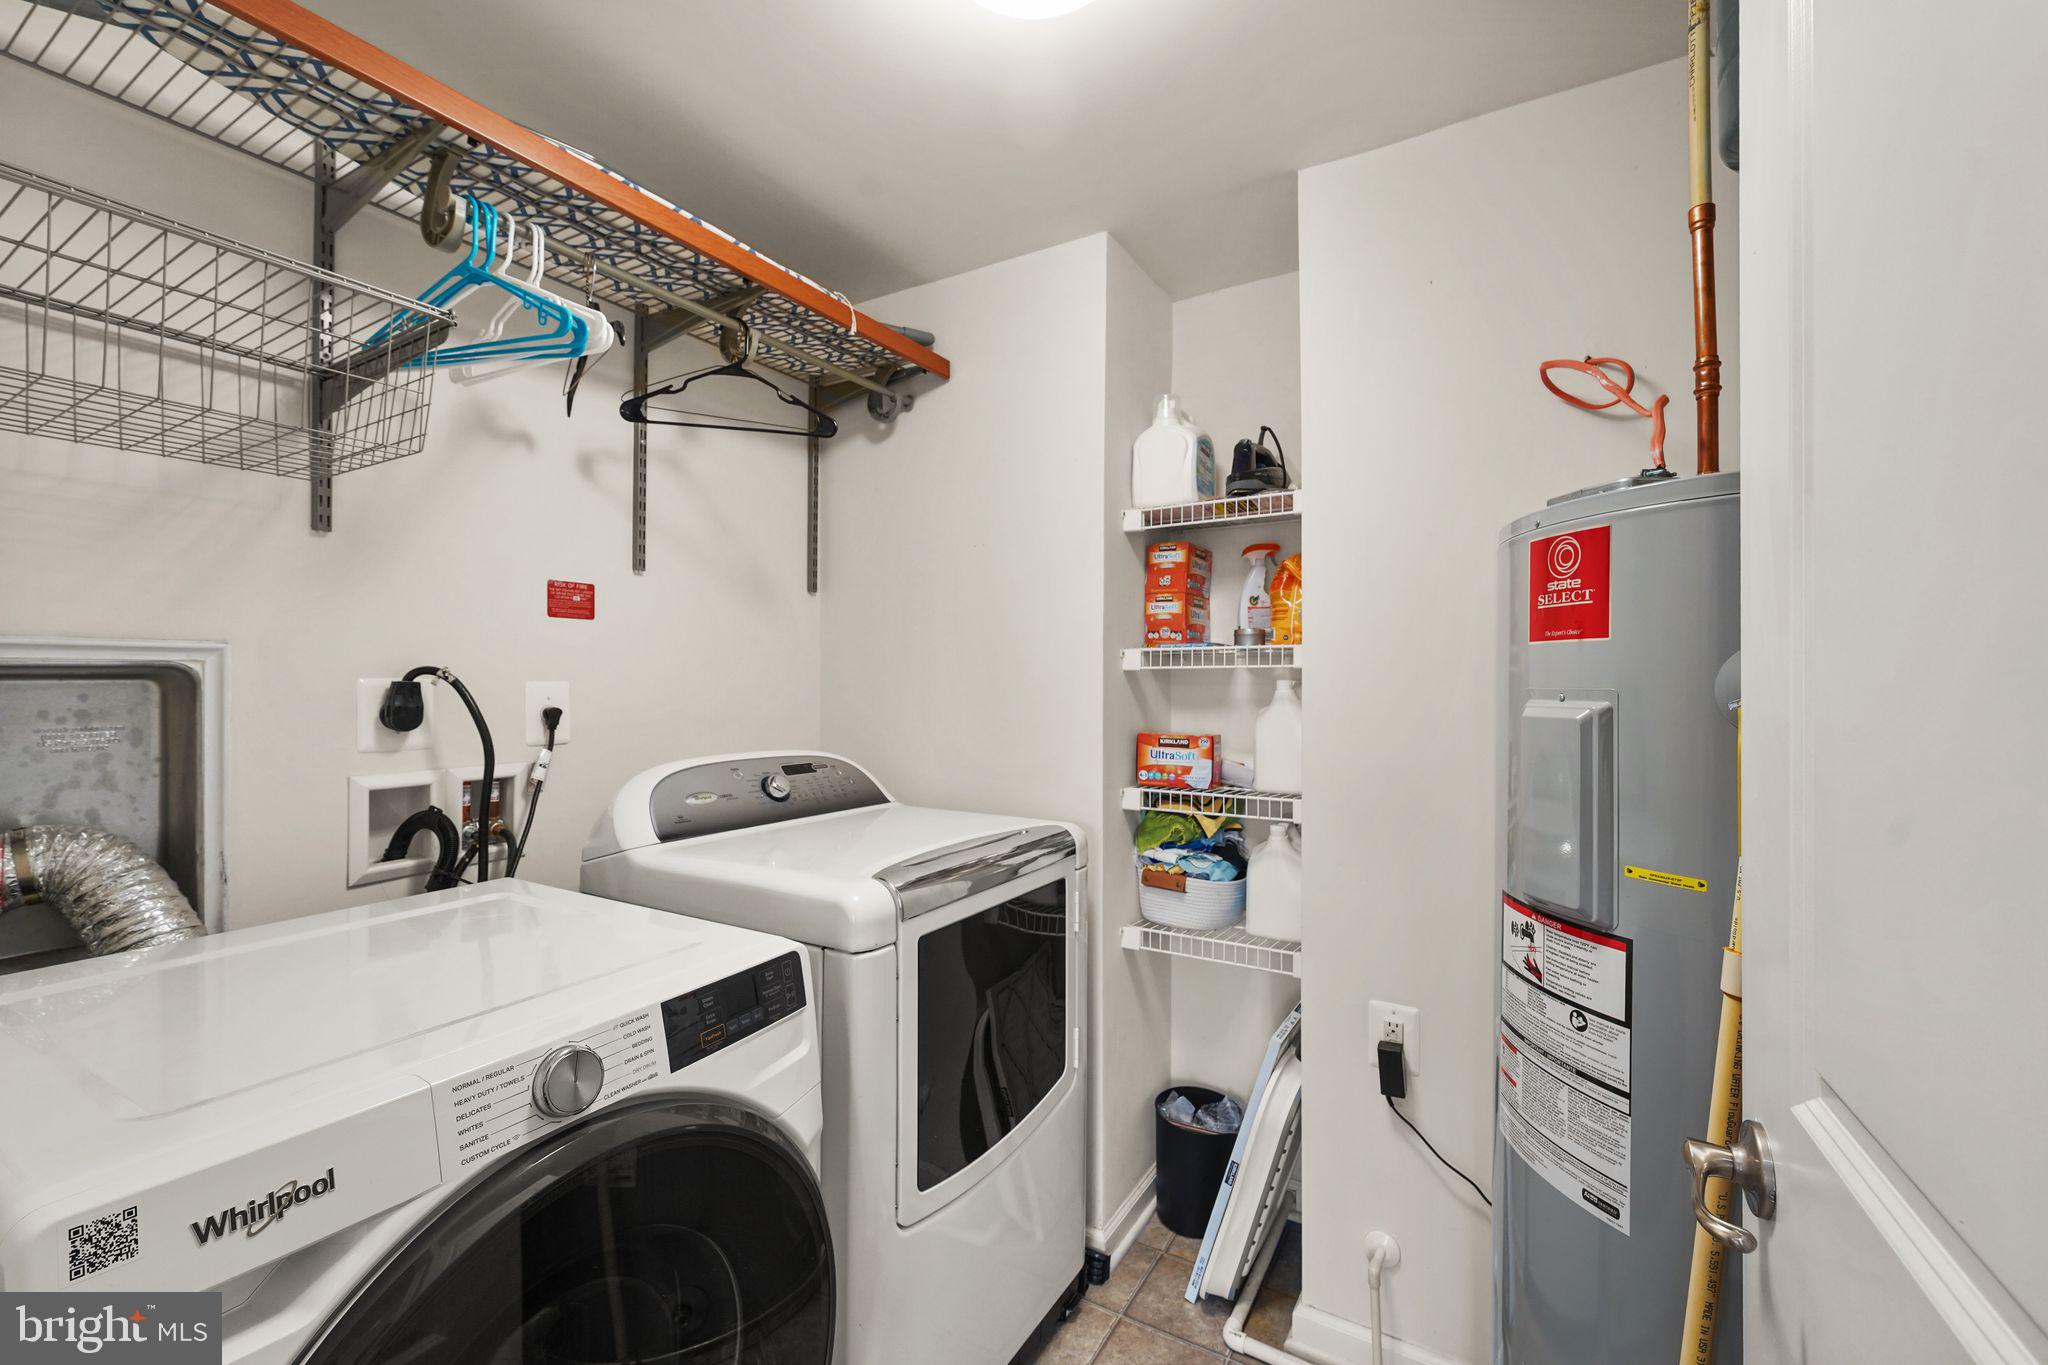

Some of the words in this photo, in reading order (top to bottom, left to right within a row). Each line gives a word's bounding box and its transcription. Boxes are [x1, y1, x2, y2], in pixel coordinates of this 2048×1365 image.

[1547, 578, 1581, 592] state
[1537, 589, 1594, 606] SELECT
[1150, 749, 1195, 760] UltraSoft
[1537, 915, 1562, 931] DANGER
[620, 1018, 635, 1028] QUICK
[635, 1012, 649, 1023] WASH
[623, 1030, 636, 1040] COLD
[637, 1024, 651, 1034] WASH
[631, 1036, 653, 1049] BEDDING
[624, 1055, 639, 1065] DRAIN
[643, 1048, 655, 1056] SPIN
[632, 1066, 643, 1075] DRY
[643, 1060, 657, 1070] DRUM
[451, 1077, 480, 1093] NORMAL
[485, 1064, 515, 1080] REGULAR
[453, 1094, 477, 1108] HEAVY
[477, 1086, 495, 1099] DUTY
[499, 1075, 525, 1090] TOWELS
[603, 1089, 620, 1101] CLEAN
[621, 1079, 641, 1092] WASHER
[455, 1103, 492, 1122] DELICATES
[457, 1121, 484, 1136] WHITES
[459, 1133, 489, 1151] SANITIZE
[460, 1149, 490, 1166] CUSTOM
[490, 1138, 511, 1152] CYCLE
[190, 1167, 336, 1247] Whirlpool
[1701, 1301, 1714, 1322] MADE
[1700, 1325, 1711, 1336] IN
[1698, 1339, 1708, 1354] USA
